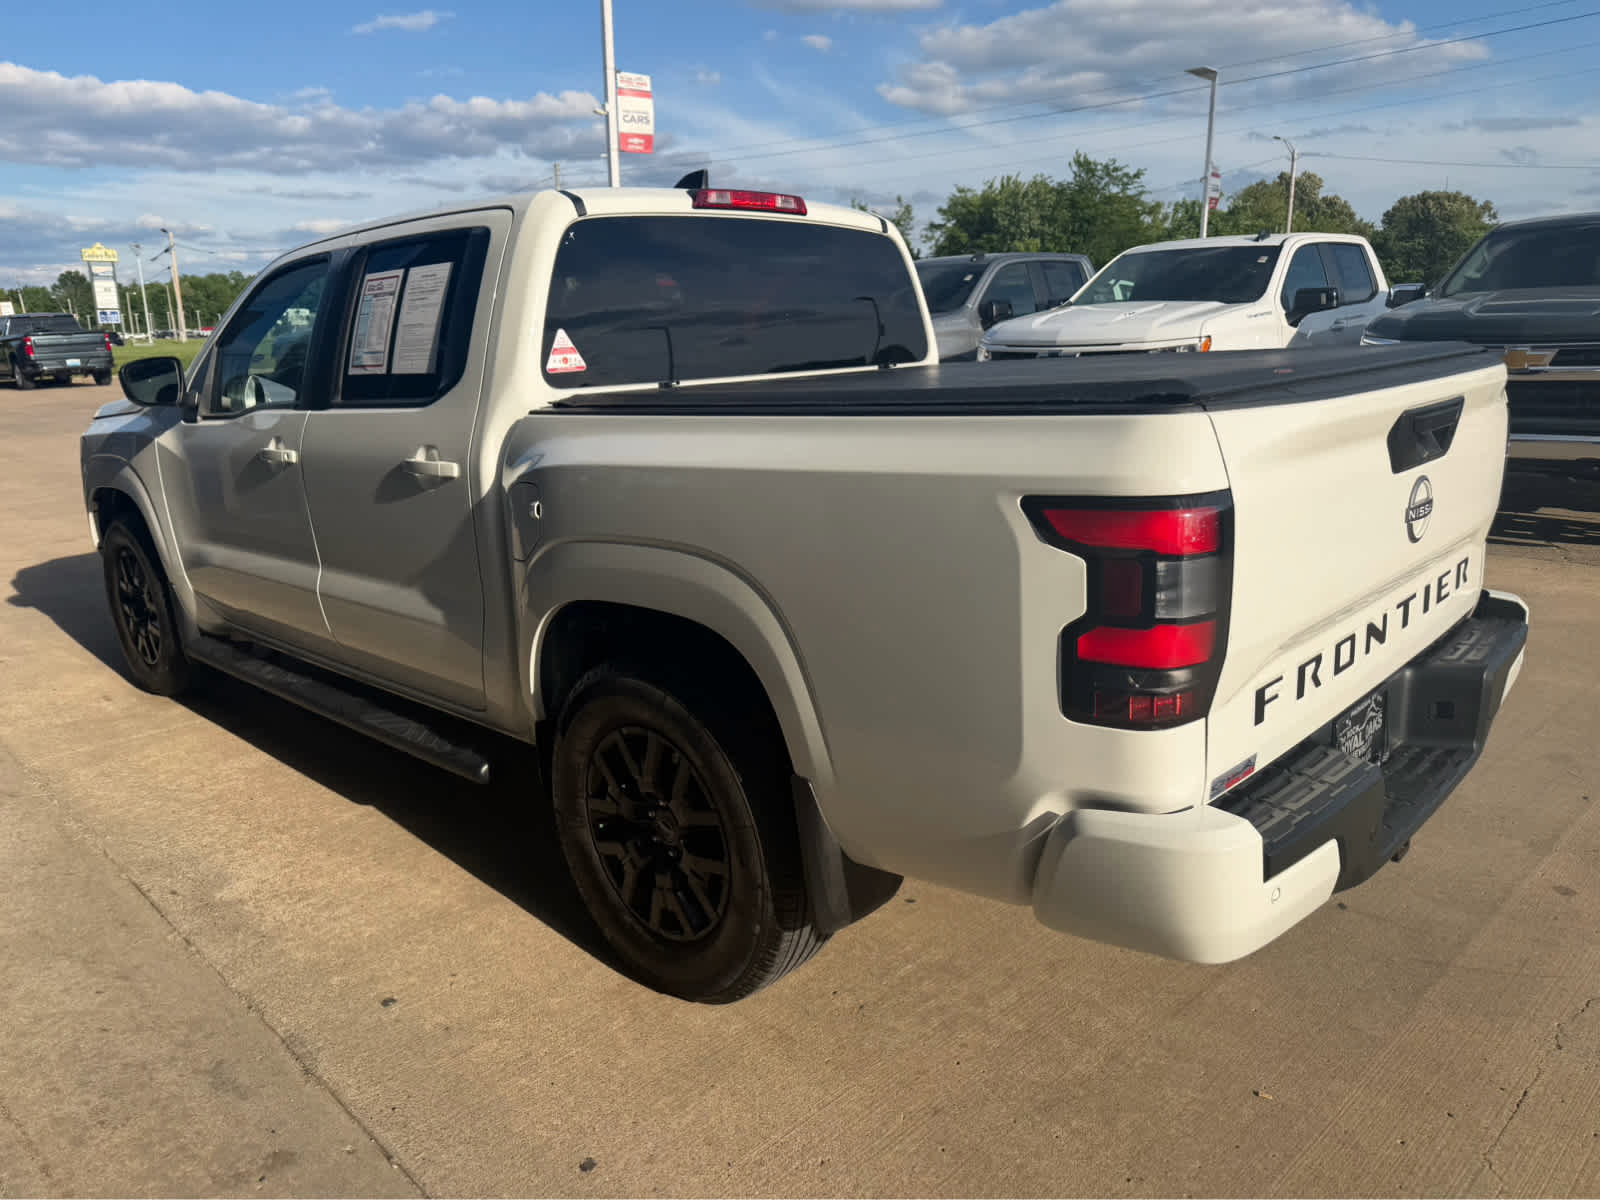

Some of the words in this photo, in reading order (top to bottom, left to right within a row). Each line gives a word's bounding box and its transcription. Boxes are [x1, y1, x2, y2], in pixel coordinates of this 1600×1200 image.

[623, 114, 650, 125] CARS
[1409, 503, 1432, 520] NISS
[1254, 556, 1469, 727] FRONTIER
